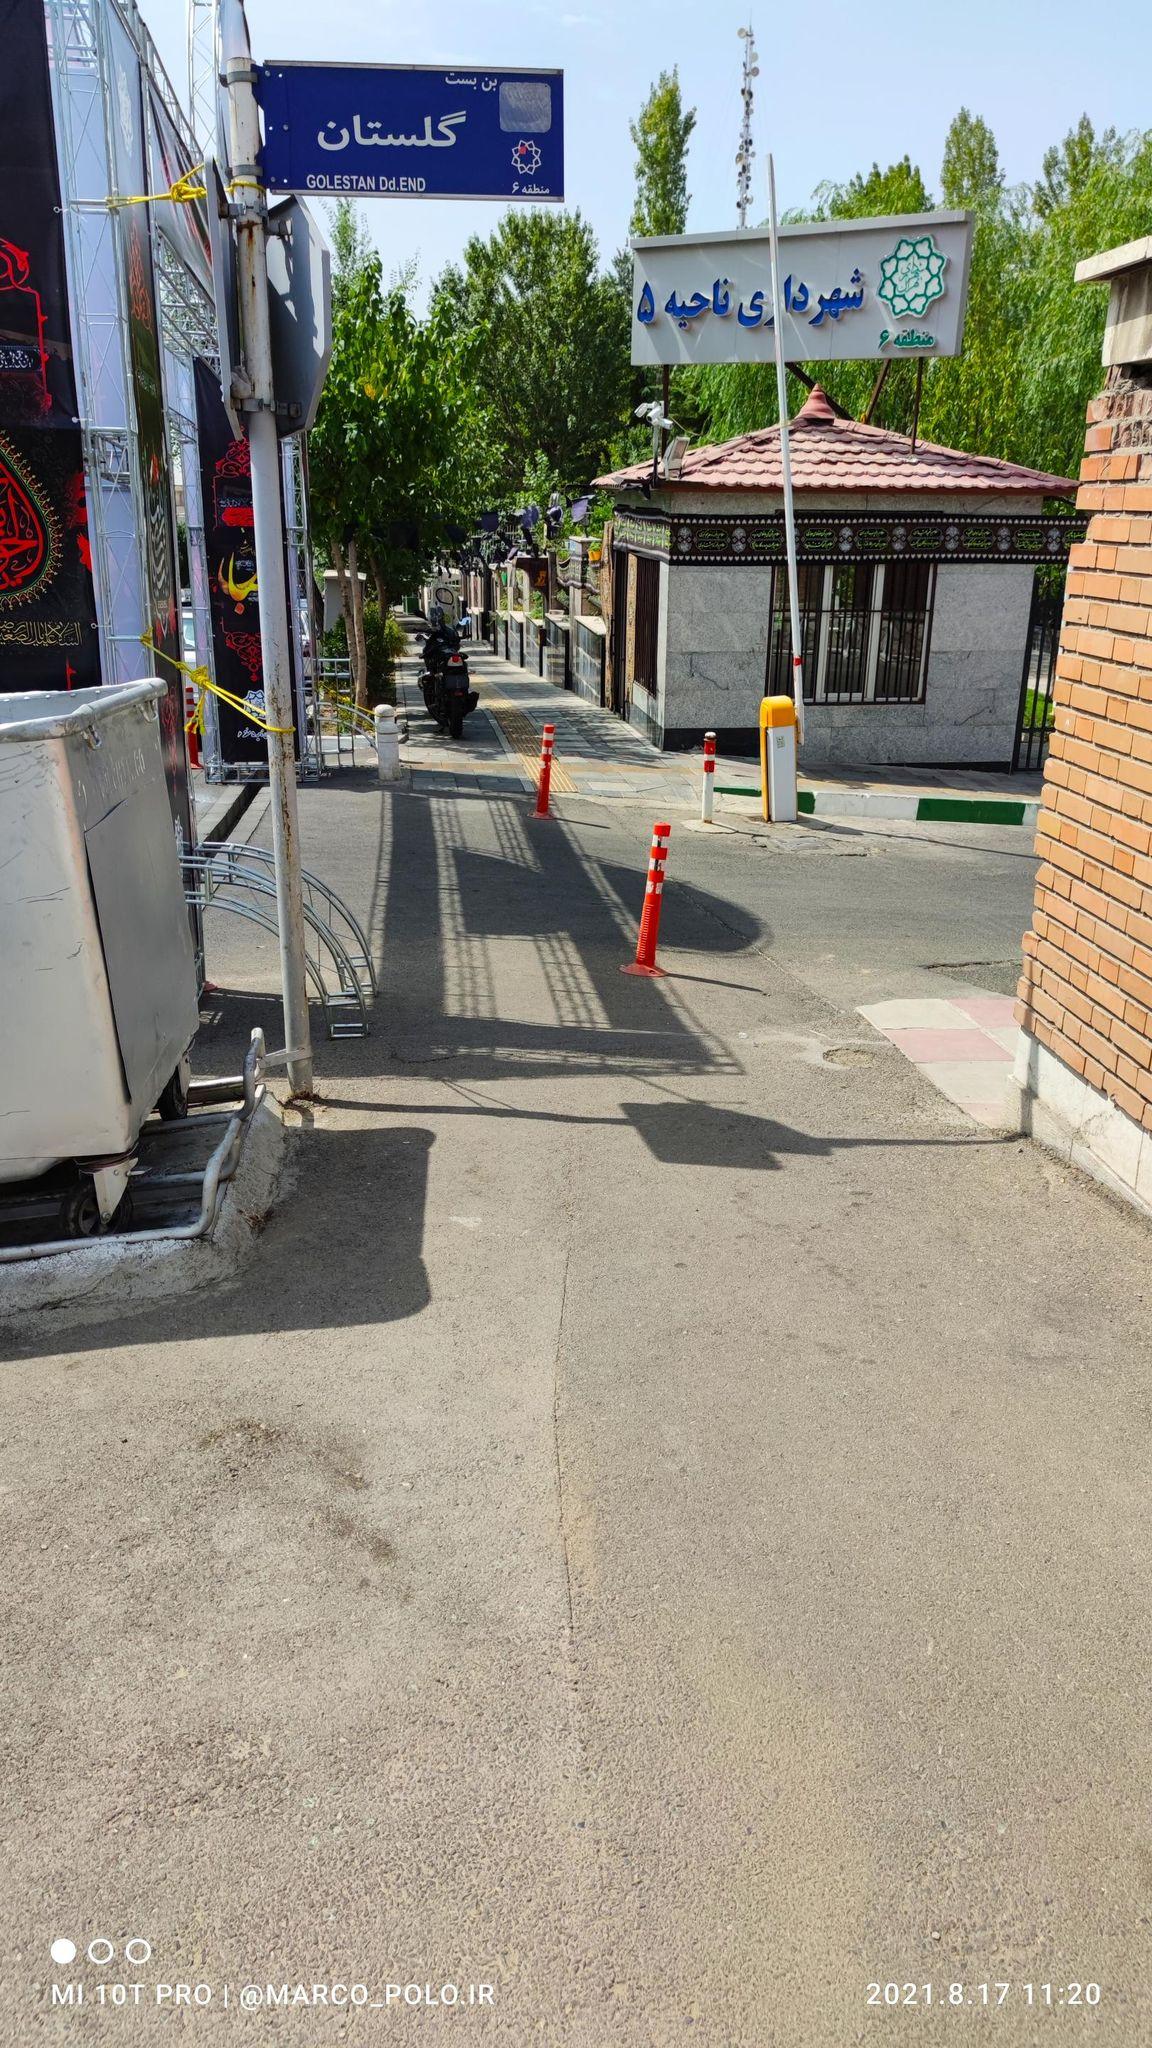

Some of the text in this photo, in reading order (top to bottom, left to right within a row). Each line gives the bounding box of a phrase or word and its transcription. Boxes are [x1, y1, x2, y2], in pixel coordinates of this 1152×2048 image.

[445, 72, 498, 92] بن بست
[317, 110, 467, 151] گلستان
[306, 174, 426, 192] GOLESTAN Dd.END
[511, 181, 550, 194] منطقه ۶
[636, 281, 655, 323] ۵
[664, 278, 731, 328] ناحیه
[878, 328, 934, 349] منطقه ۶
